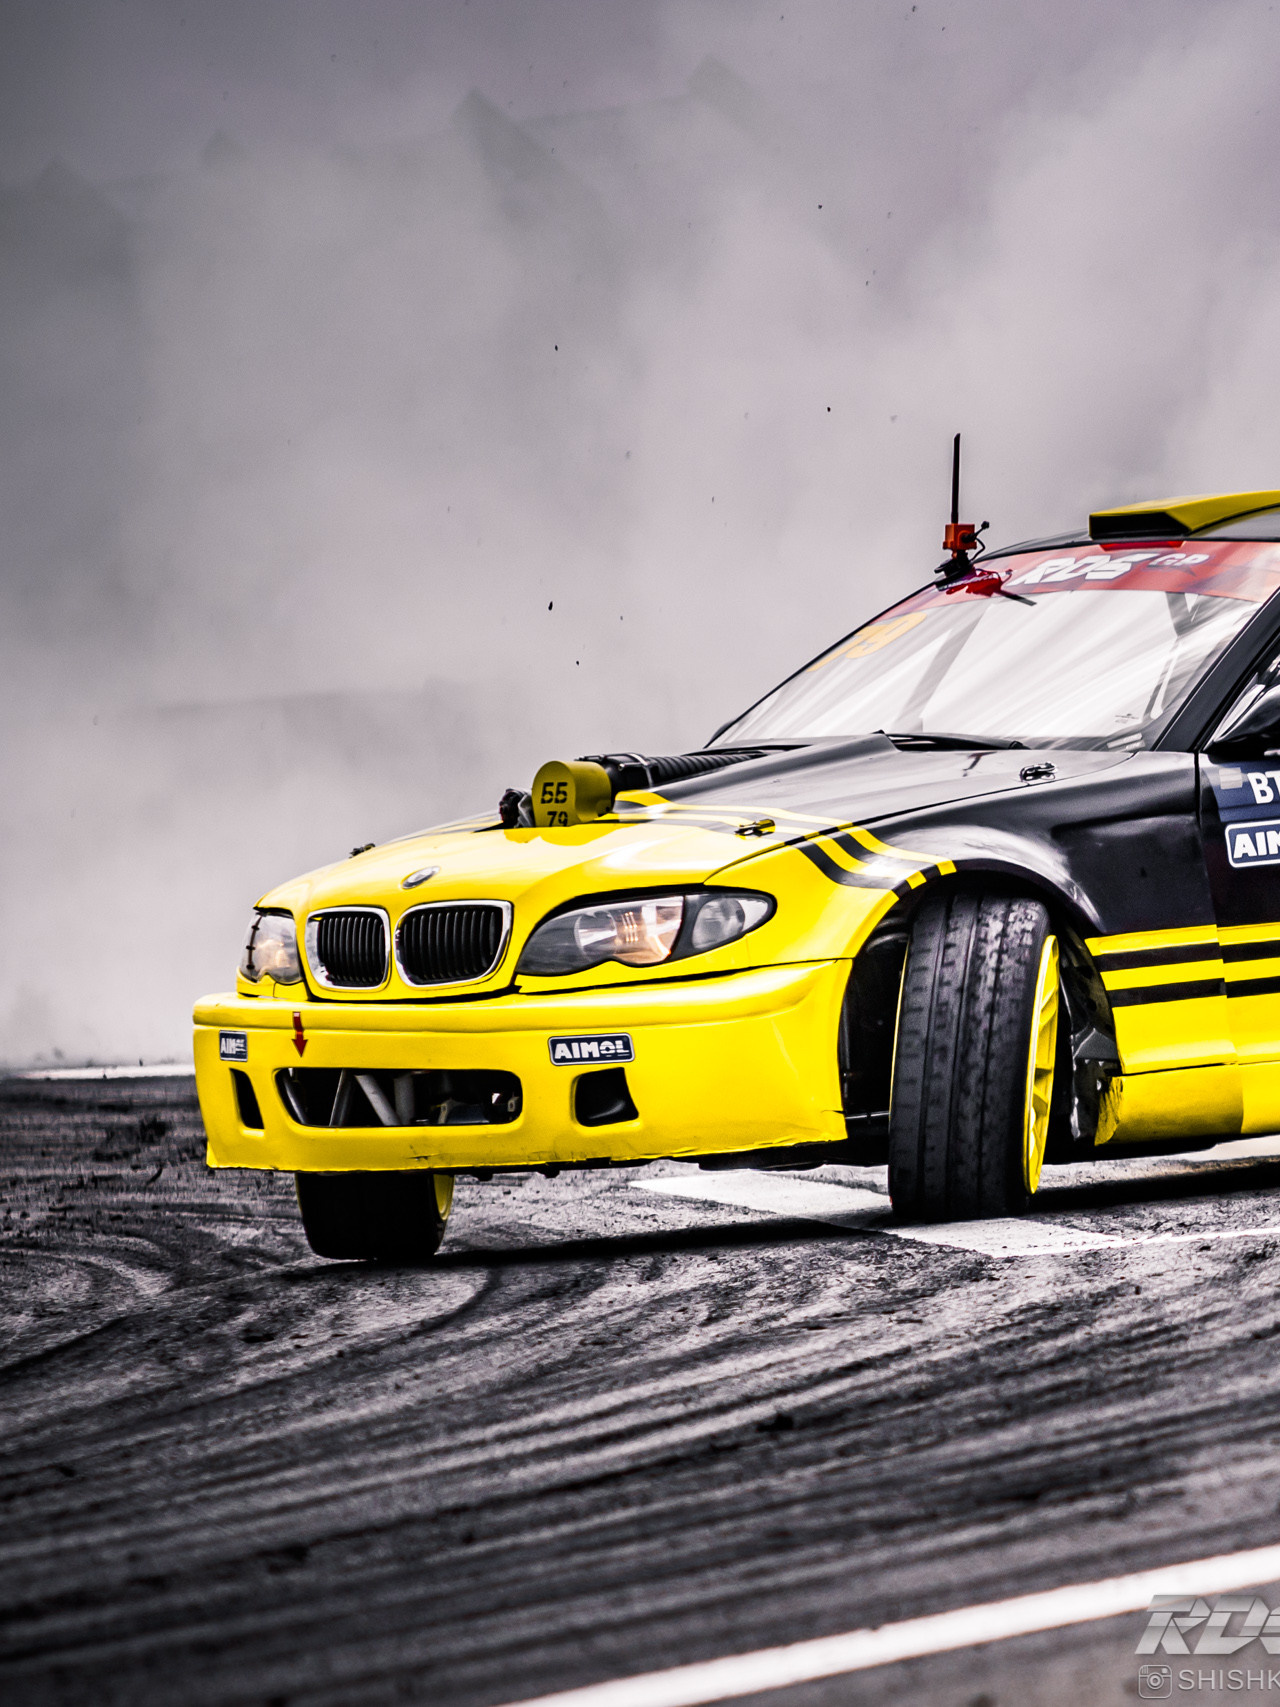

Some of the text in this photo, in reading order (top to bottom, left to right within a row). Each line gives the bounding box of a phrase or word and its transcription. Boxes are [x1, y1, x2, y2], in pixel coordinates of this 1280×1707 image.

[1006, 553, 1210, 587] RDS GP
[806, 612, 927, 672] 79
[547, 811, 568, 827] 79
[554, 1040, 630, 1059] AIMOL
